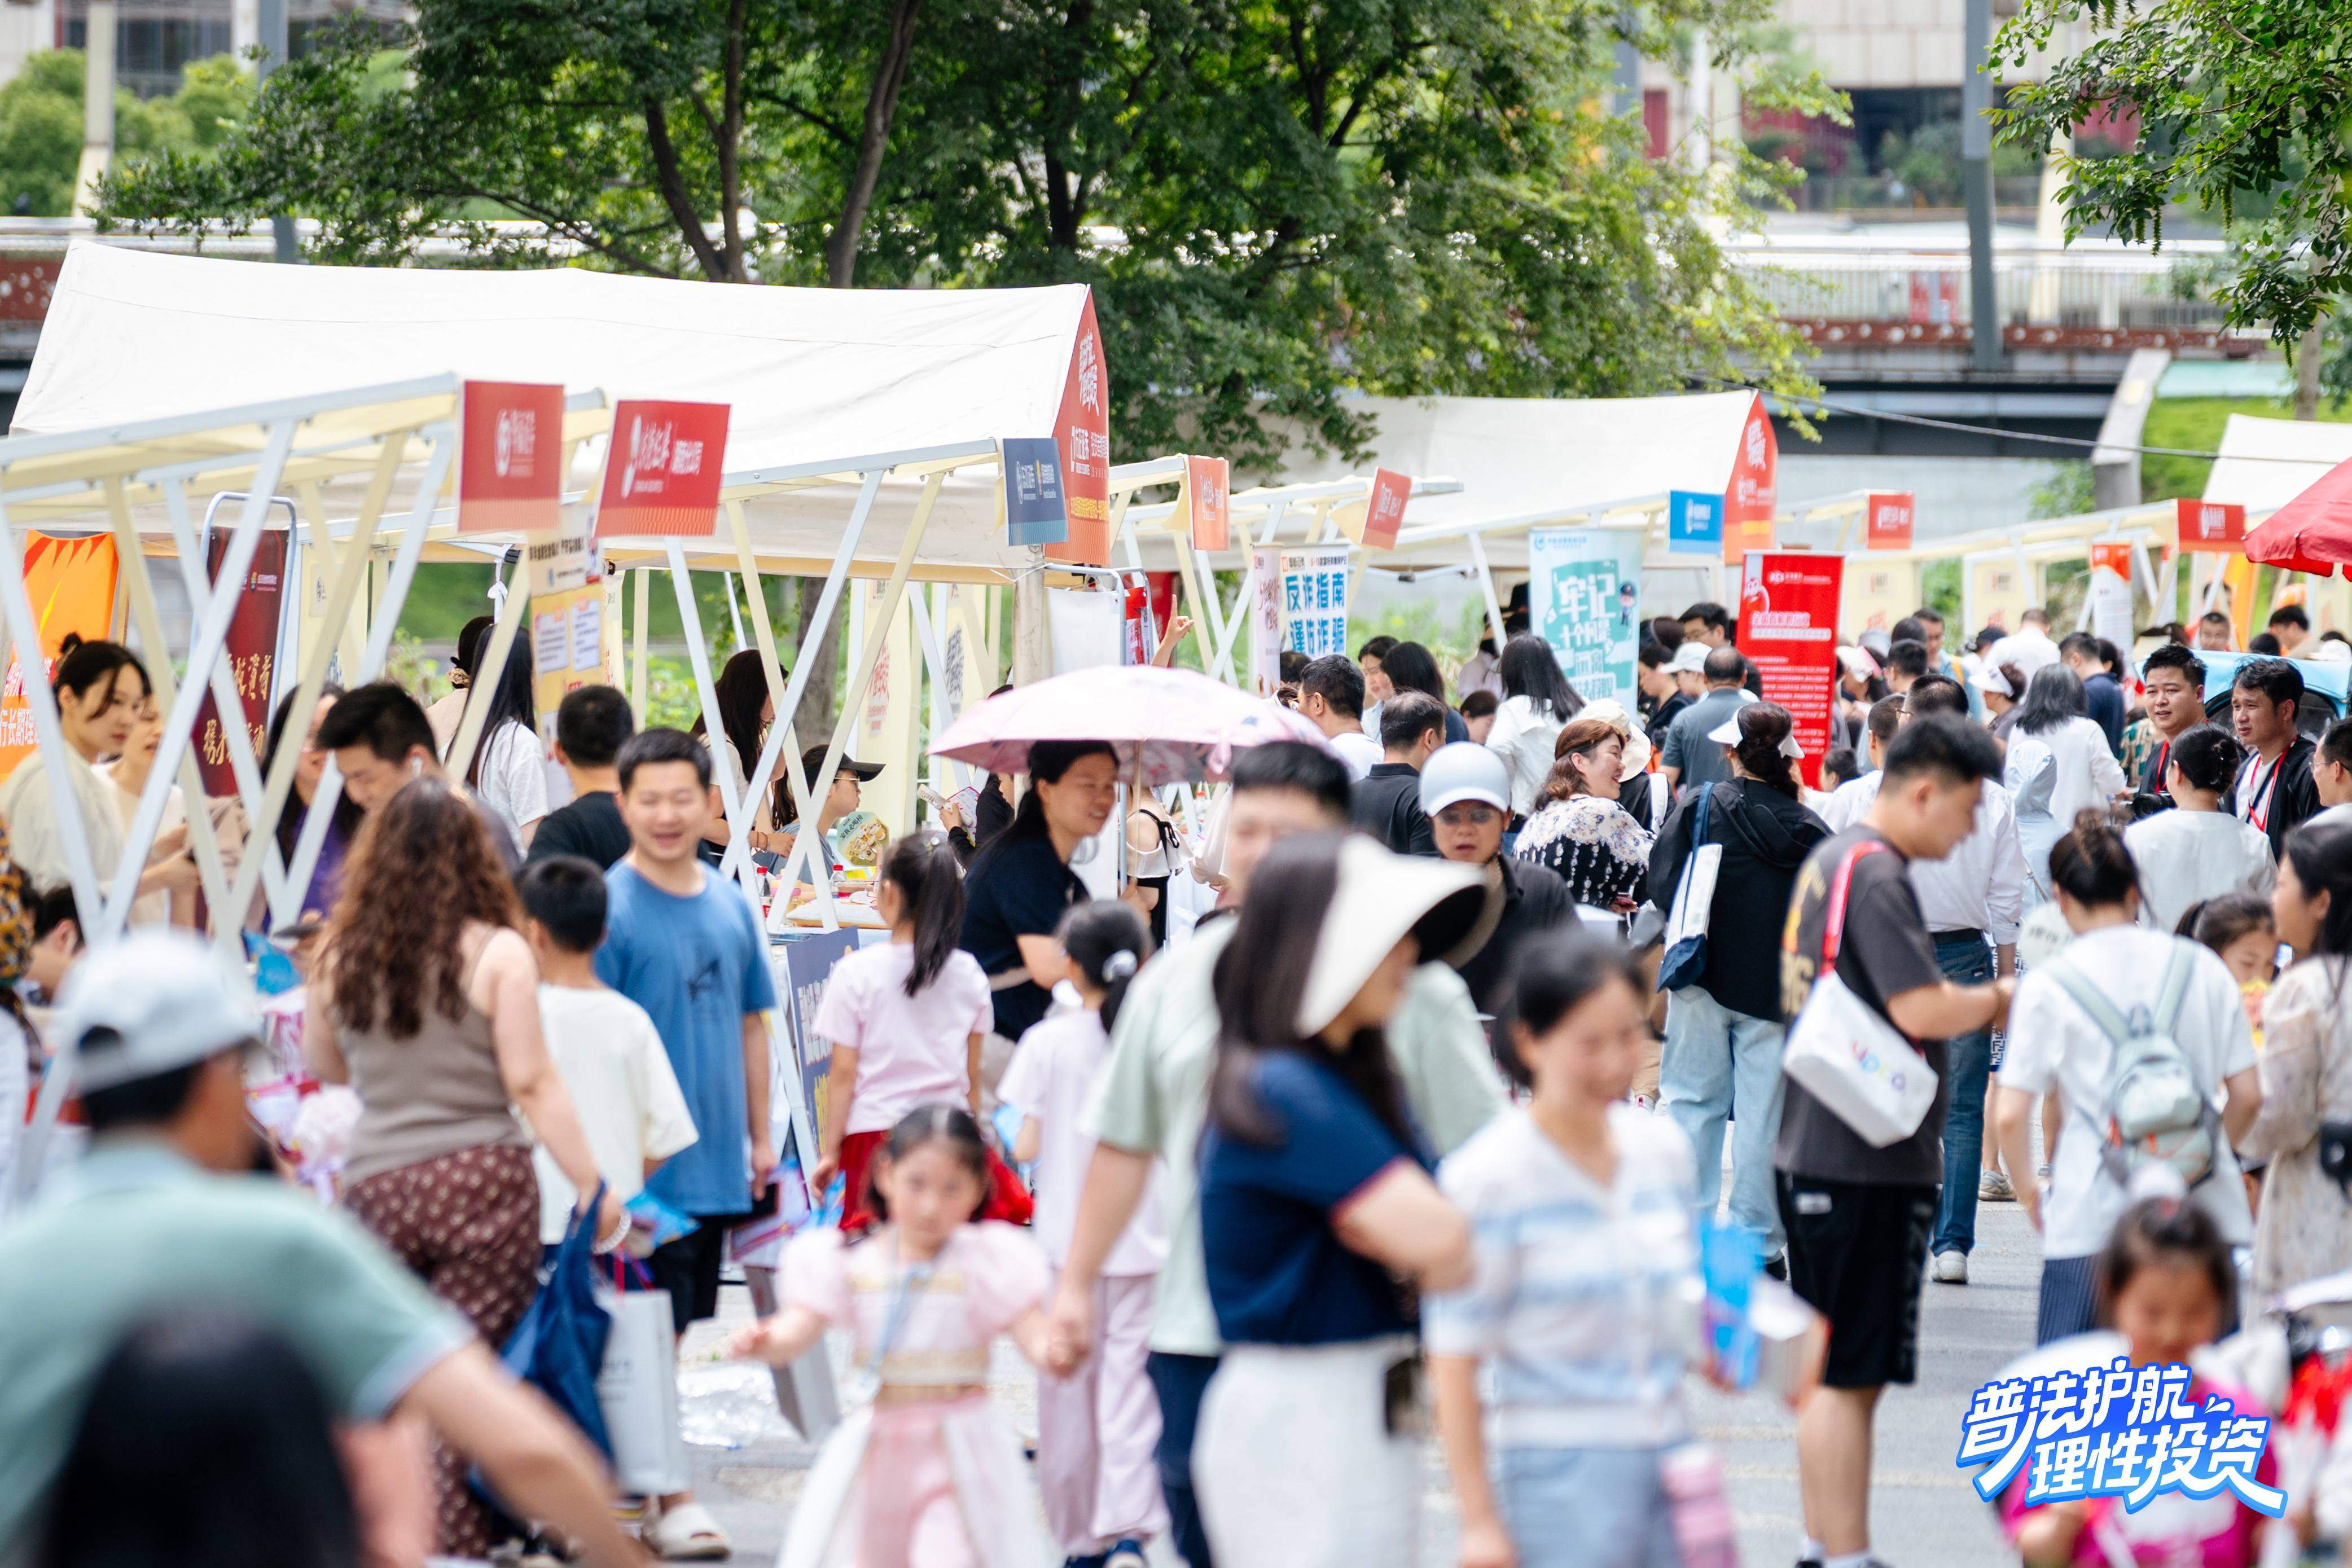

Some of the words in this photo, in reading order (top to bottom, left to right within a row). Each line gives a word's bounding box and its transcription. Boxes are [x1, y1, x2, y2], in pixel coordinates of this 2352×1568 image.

[1285, 572, 1345, 612] 反诈指南
[1558, 573, 1617, 623] 牢记
[1290, 617, 1345, 656] 谨防诈骗
